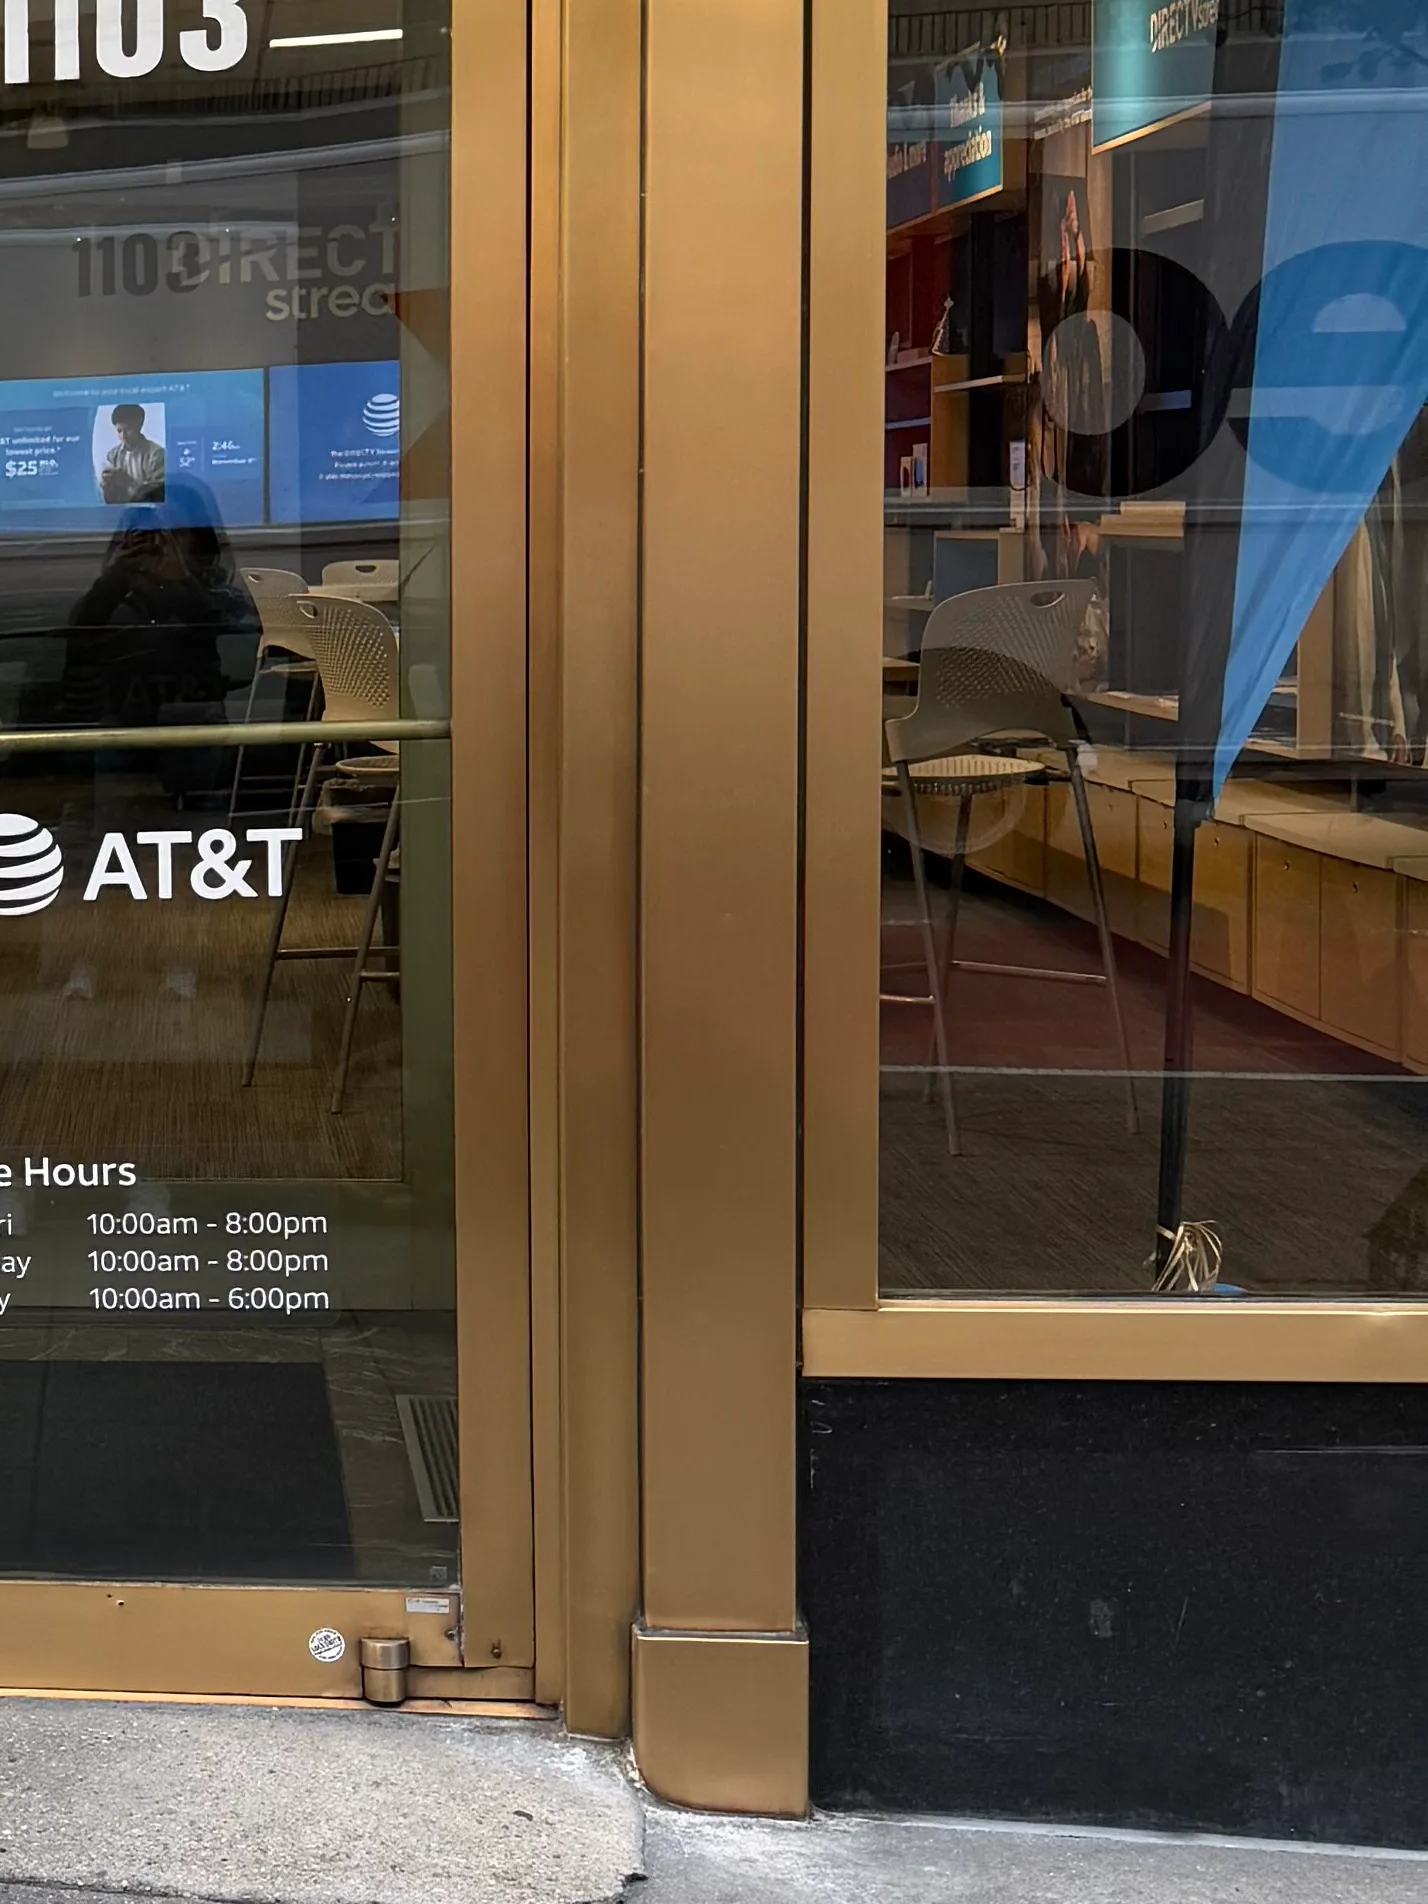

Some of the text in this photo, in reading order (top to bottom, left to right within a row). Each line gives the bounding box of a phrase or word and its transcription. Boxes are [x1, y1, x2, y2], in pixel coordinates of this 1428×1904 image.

[5, 459, 38, 479] $25
[82, 827, 303, 902] AT&T
[24, 1156, 137, 1187] Hours
[86, 1212, 199, 1236] 10:00am
[225, 1211, 328, 1240] 8:00pm
[87, 1249, 200, 1274] 10:00am
[226, 1248, 329, 1277] 8:00pm
[89, 1287, 201, 1311] 10:00am
[228, 1285, 330, 1314] 6:00pm
